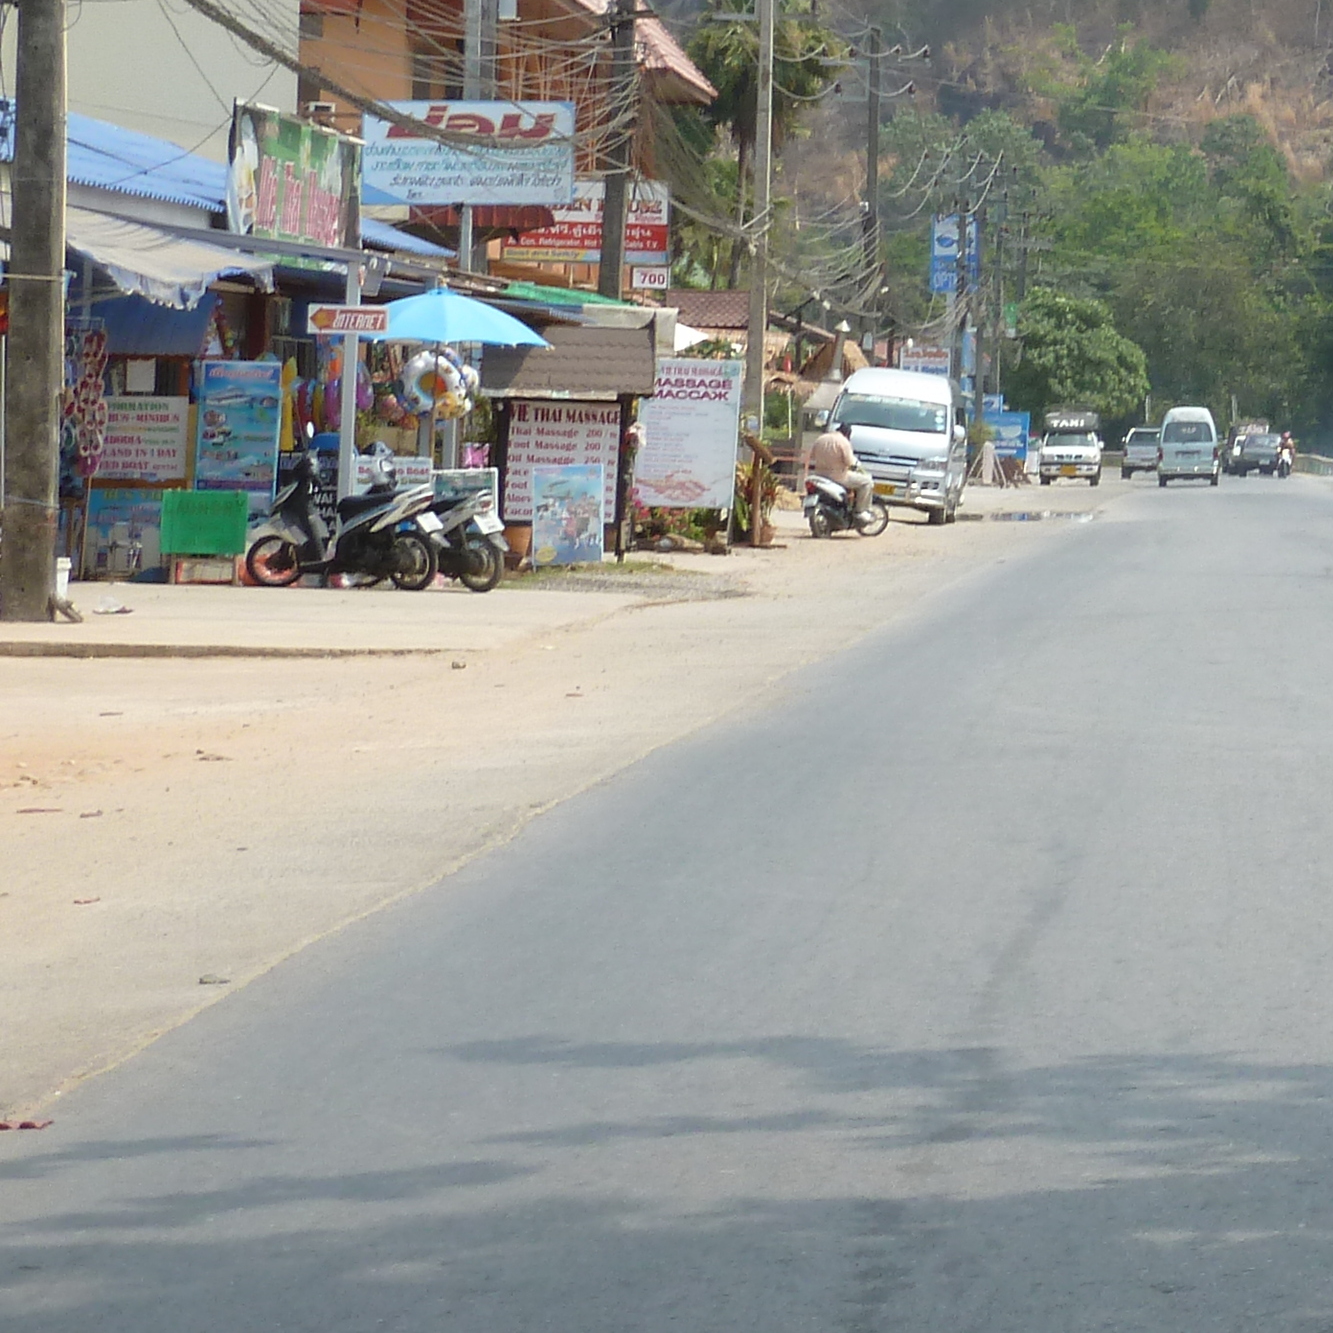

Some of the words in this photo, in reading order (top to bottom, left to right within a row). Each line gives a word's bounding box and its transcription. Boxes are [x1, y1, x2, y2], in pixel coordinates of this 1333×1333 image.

[640, 273, 665, 285] 700
[333, 311, 383, 330] INTERNET
[534, 407, 563, 423] THAI
[565, 408, 620, 425] MASSAGE
[1051, 418, 1085, 428] TAXI
[511, 427, 532, 436] Thai
[536, 427, 579, 439] Massage
[534, 440, 578, 452] Massage
